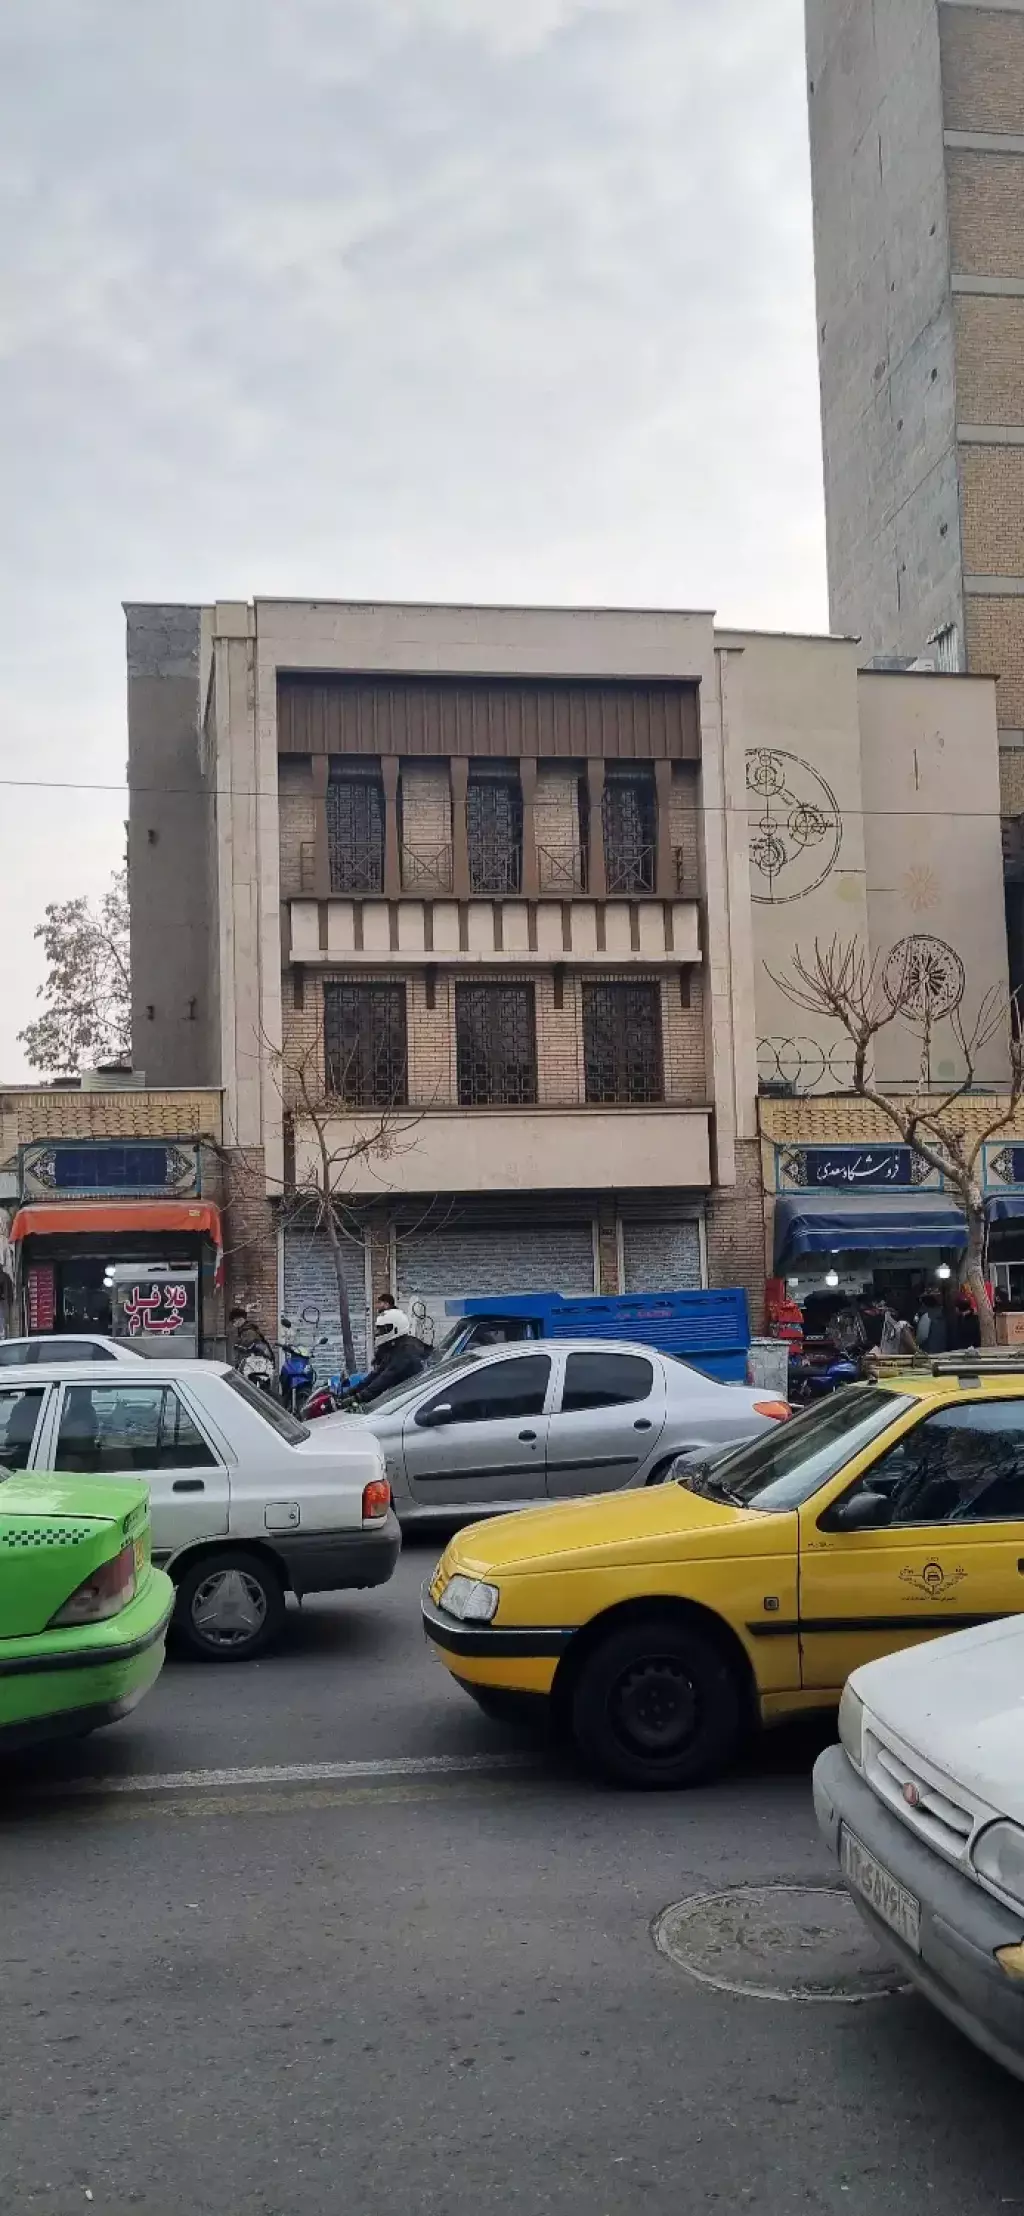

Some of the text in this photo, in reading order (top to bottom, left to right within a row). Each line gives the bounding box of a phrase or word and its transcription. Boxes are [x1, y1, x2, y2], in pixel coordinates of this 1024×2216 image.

[817, 1154, 899, 1181] فروشگاه سعدی
[128, 1308, 184, 1336] خیام
